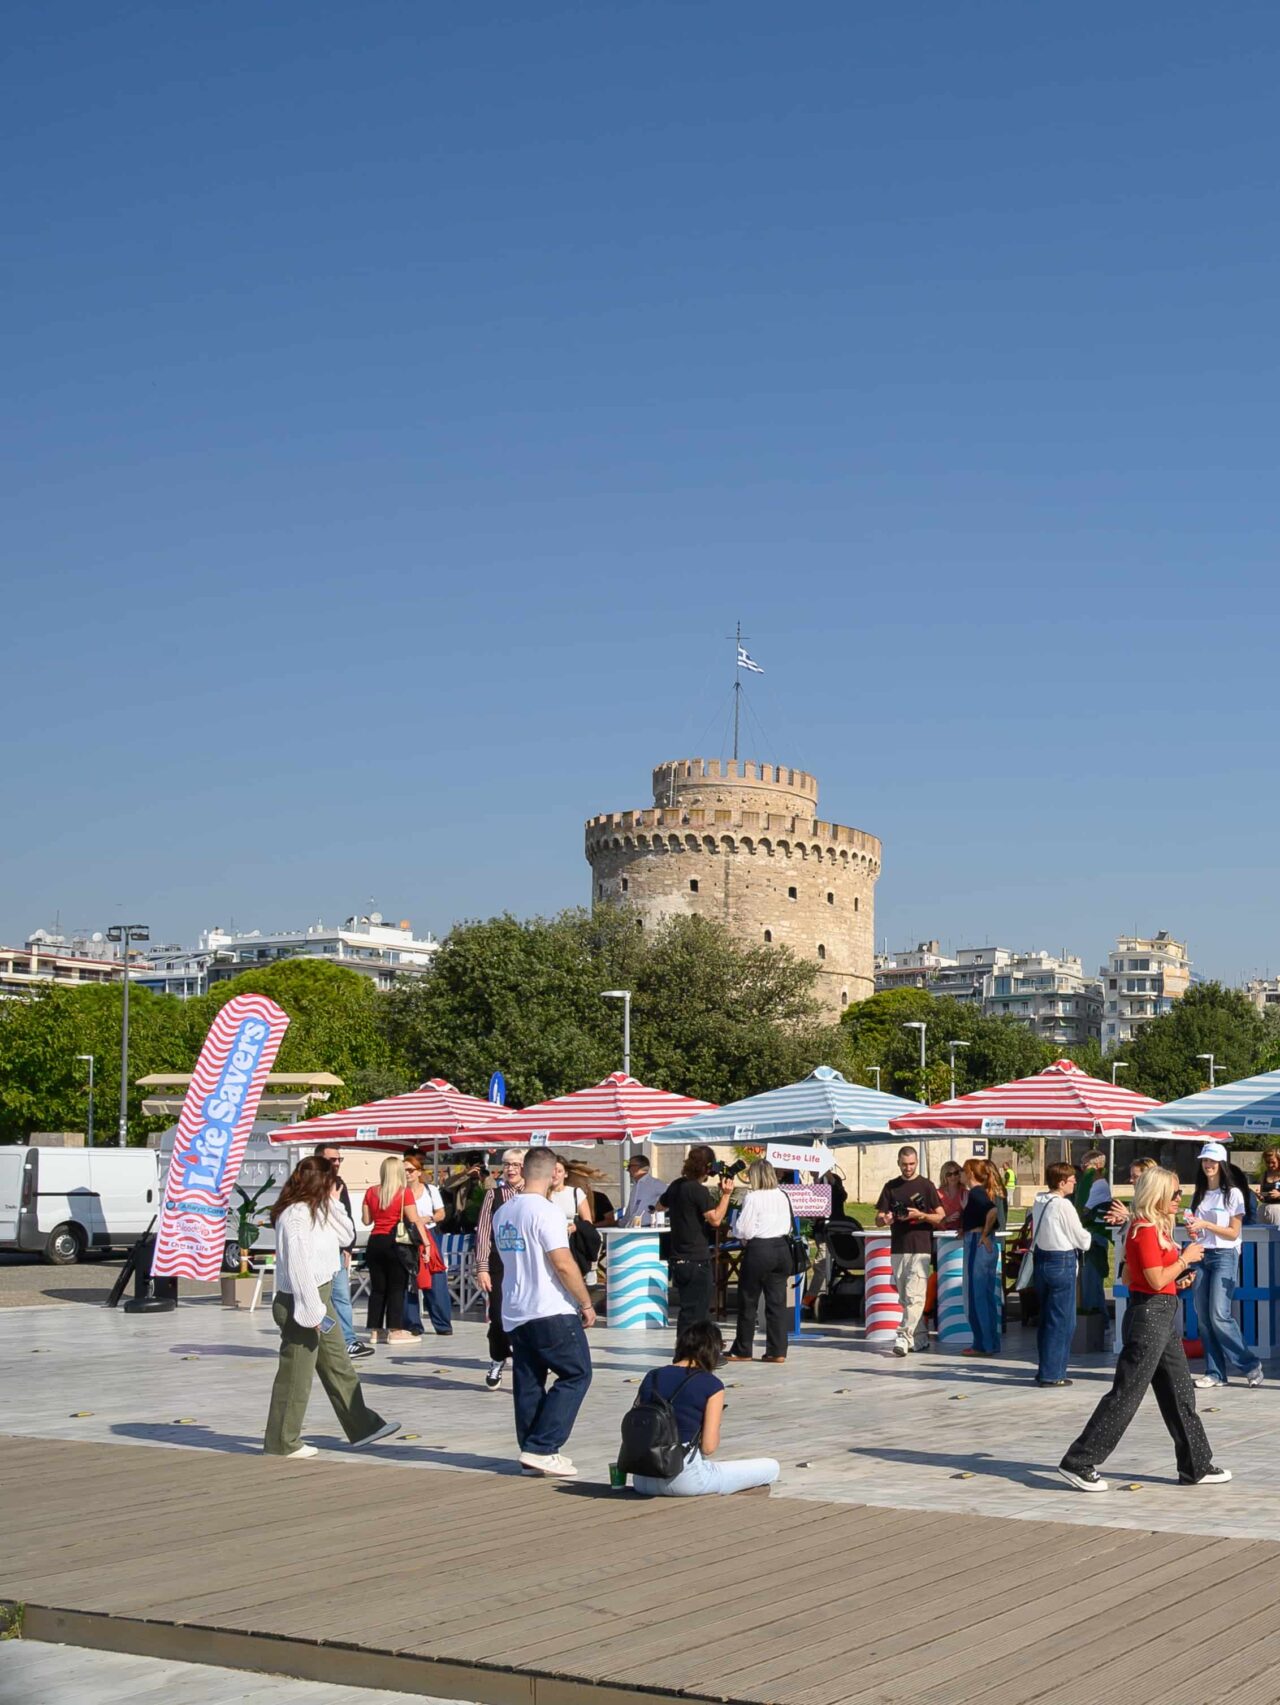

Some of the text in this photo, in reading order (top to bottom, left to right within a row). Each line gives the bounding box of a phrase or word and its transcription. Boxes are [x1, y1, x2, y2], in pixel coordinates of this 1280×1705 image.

[184, 1127, 228, 1189] Life
[208, 1021, 266, 1123] Savers
[974, 1144, 985, 1153] WC
[771, 1151, 820, 1163] Choose Life
